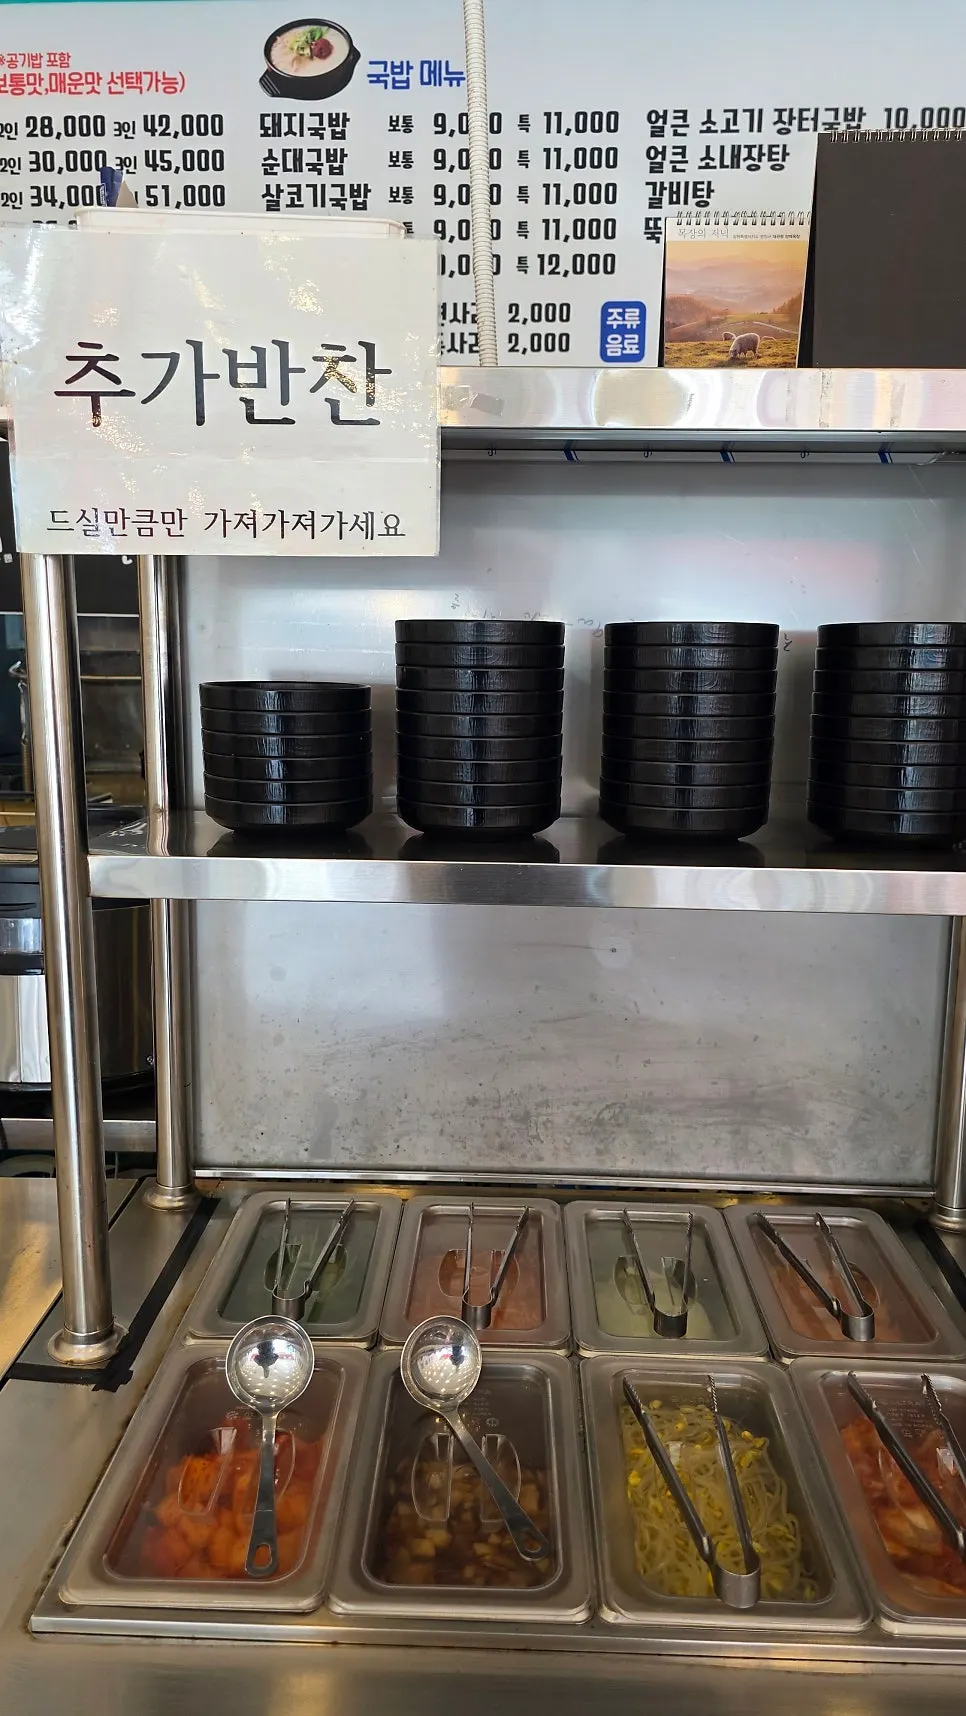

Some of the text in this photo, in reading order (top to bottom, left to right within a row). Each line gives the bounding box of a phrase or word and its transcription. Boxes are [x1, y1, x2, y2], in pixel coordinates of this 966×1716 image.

[46, 52, 71, 68] 포함
[107, 71, 186, 95] 선택가능)
[367, 60, 466, 90] 국밥 메뉴
[25, 115, 106, 140] 28,000
[113, 121, 136, 140] 3인
[143, 114, 224, 140] 42,000
[260, 112, 350, 140] 돼지국밥
[388, 112, 502, 138] 보통 9,00
[518, 110, 620, 137] 특 11,000
[646, 106, 966, 138] 얼큰 소고기 장터국밥 10,000
[0, 149, 225, 175] 2인 30,000 3인 45,000
[261, 148, 348, 176] 순대국밥
[388, 148, 502, 173] 보통 9,00
[517, 147, 619, 173] 특 11,000
[645, 144, 790, 174] 얼큰 소내장탕
[1, 192, 23, 210] 2인
[146, 184, 226, 210] 51,000
[261, 183, 371, 212] 살코기국밥
[388, 184, 502, 209] 보통 9,00
[517, 182, 618, 208] 특 11,000
[645, 180, 715, 210] 갈비탕
[433, 219, 502, 243] 9,00
[516, 221, 530, 239] 특
[542, 218, 617, 243] 11,000
[516, 256, 530, 274] 특
[537, 253, 616, 278] 12,000
[508, 303, 571, 325] 2,000
[606, 308, 640, 329] 주류
[507, 333, 570, 355] 2,000
[605, 334, 640, 356] 음료
[53, 339, 393, 427] 추가반찬
[46, 508, 407, 541] 드실만큼만 가져가져가세요
